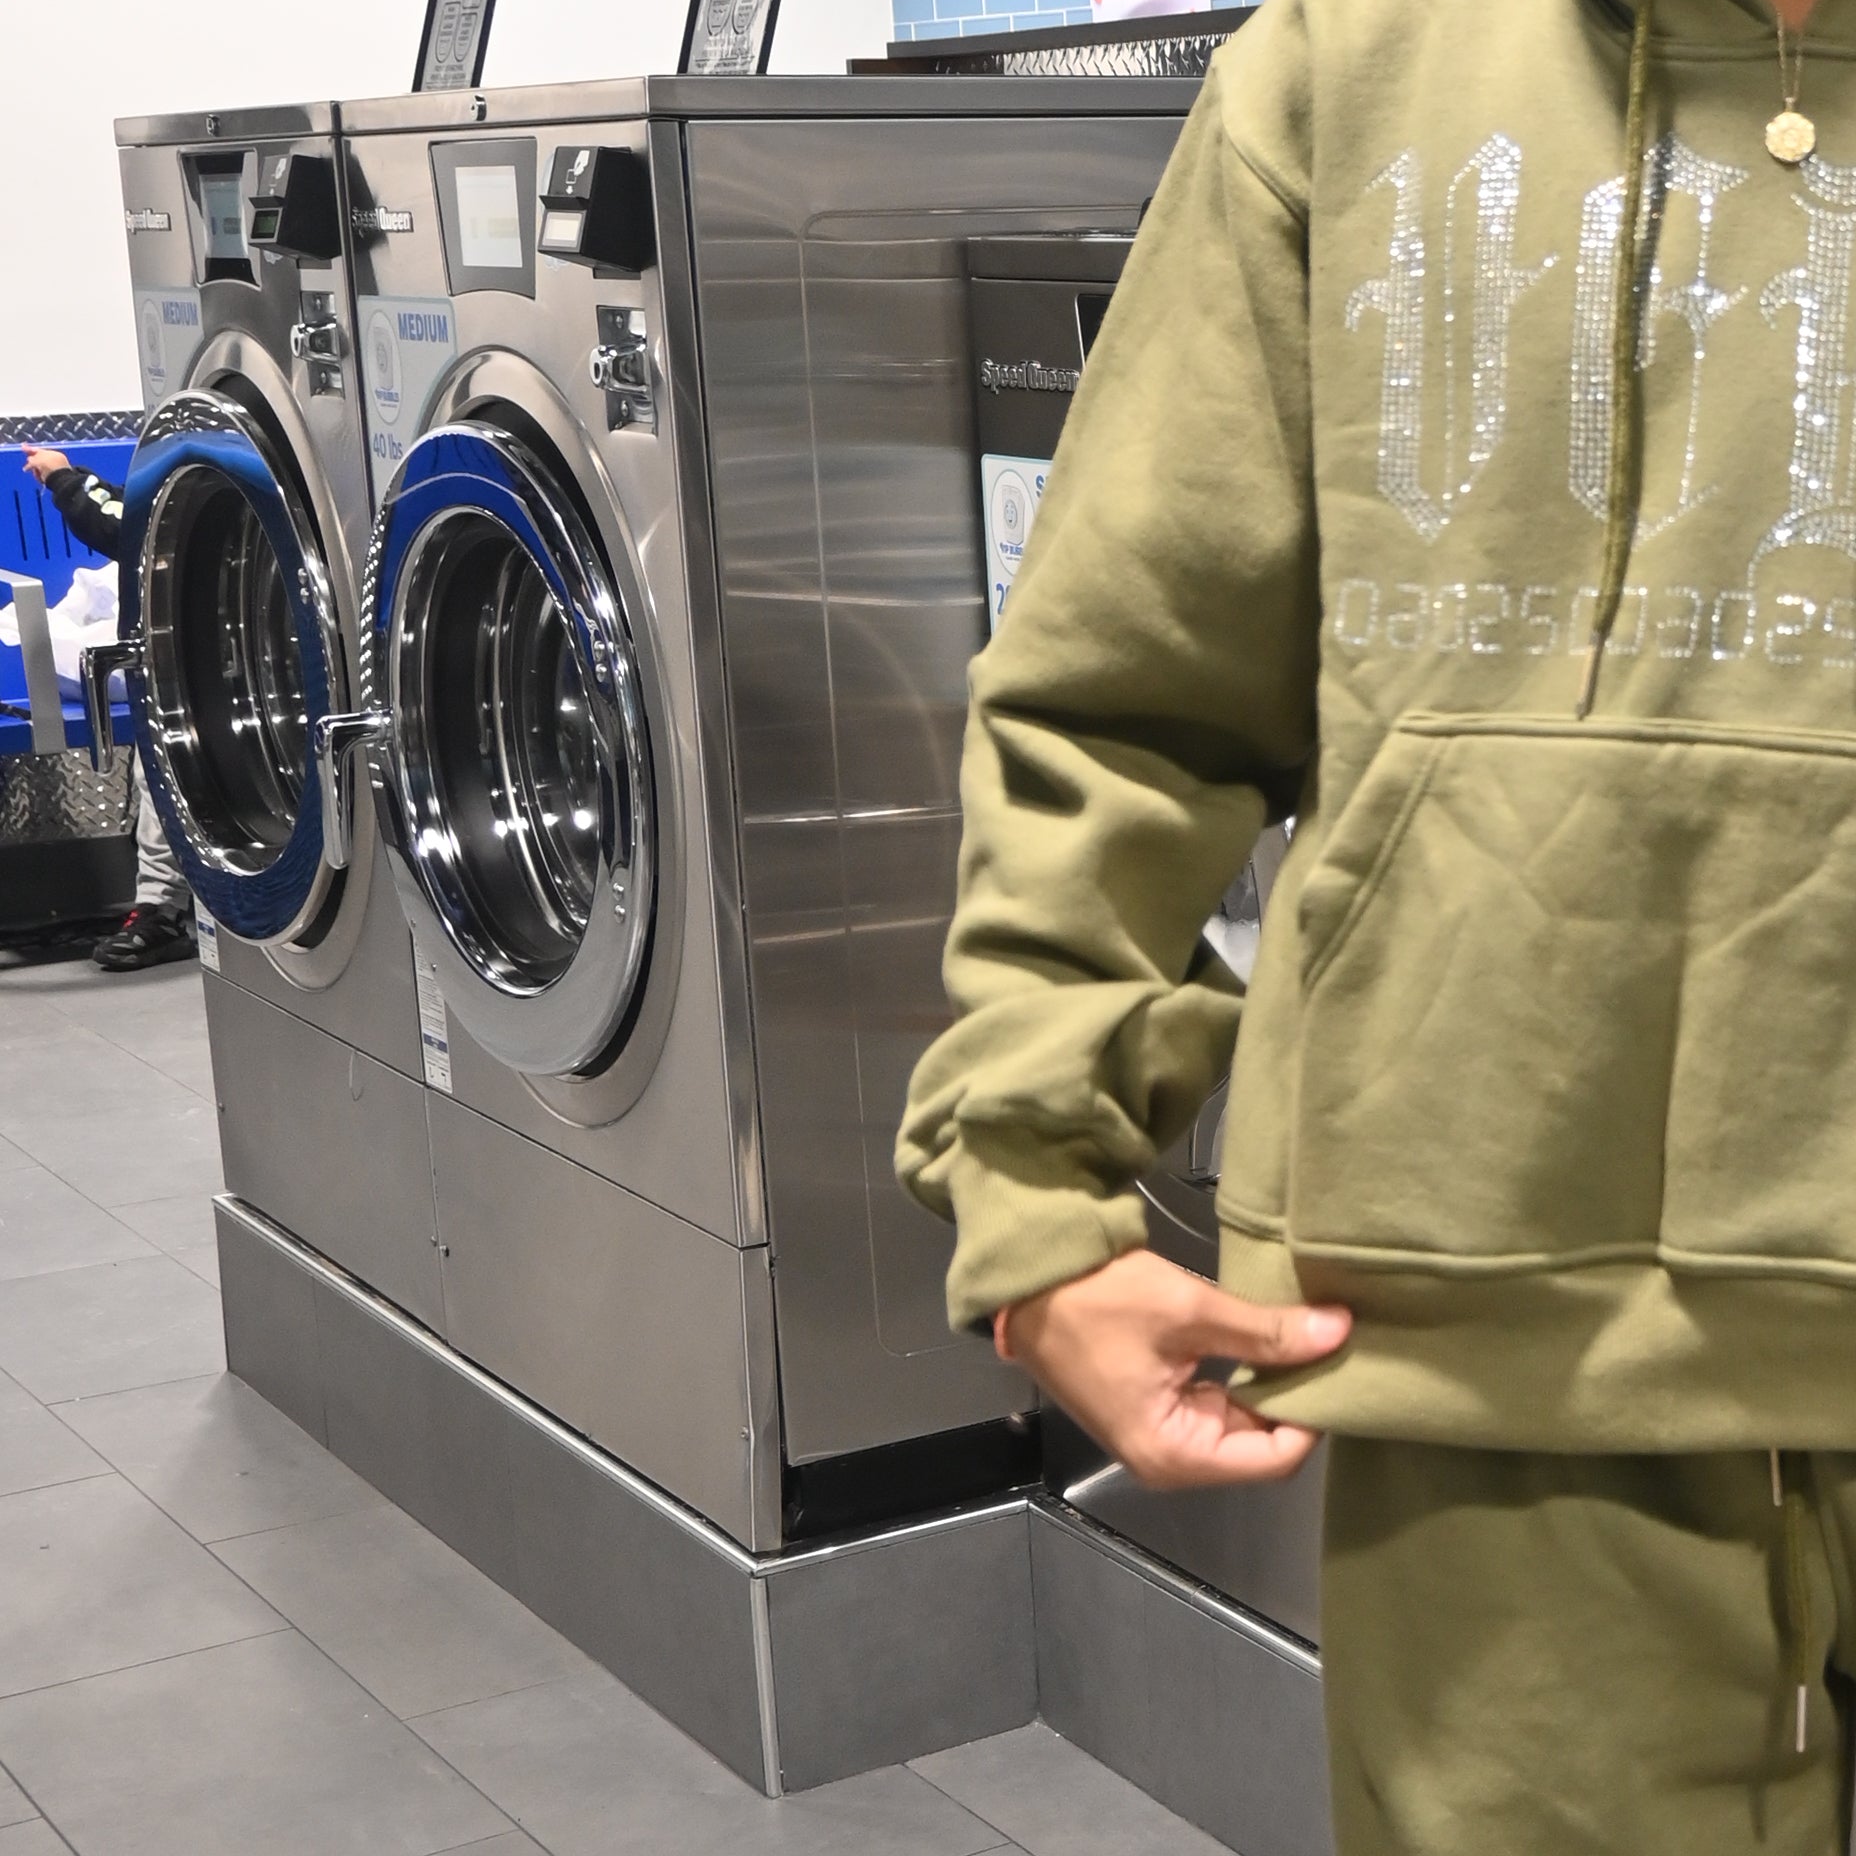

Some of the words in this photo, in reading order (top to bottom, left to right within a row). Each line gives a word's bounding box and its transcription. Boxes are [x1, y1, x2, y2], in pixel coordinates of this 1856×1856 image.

[379, 206, 413, 232] Queen
[161, 301, 199, 326] MEDIUM
[397, 312, 449, 343] MEDIUM
[981, 358, 1026, 393] Speed
[1027, 360, 1079, 392] Queen
[373, 432, 387, 459] 40
